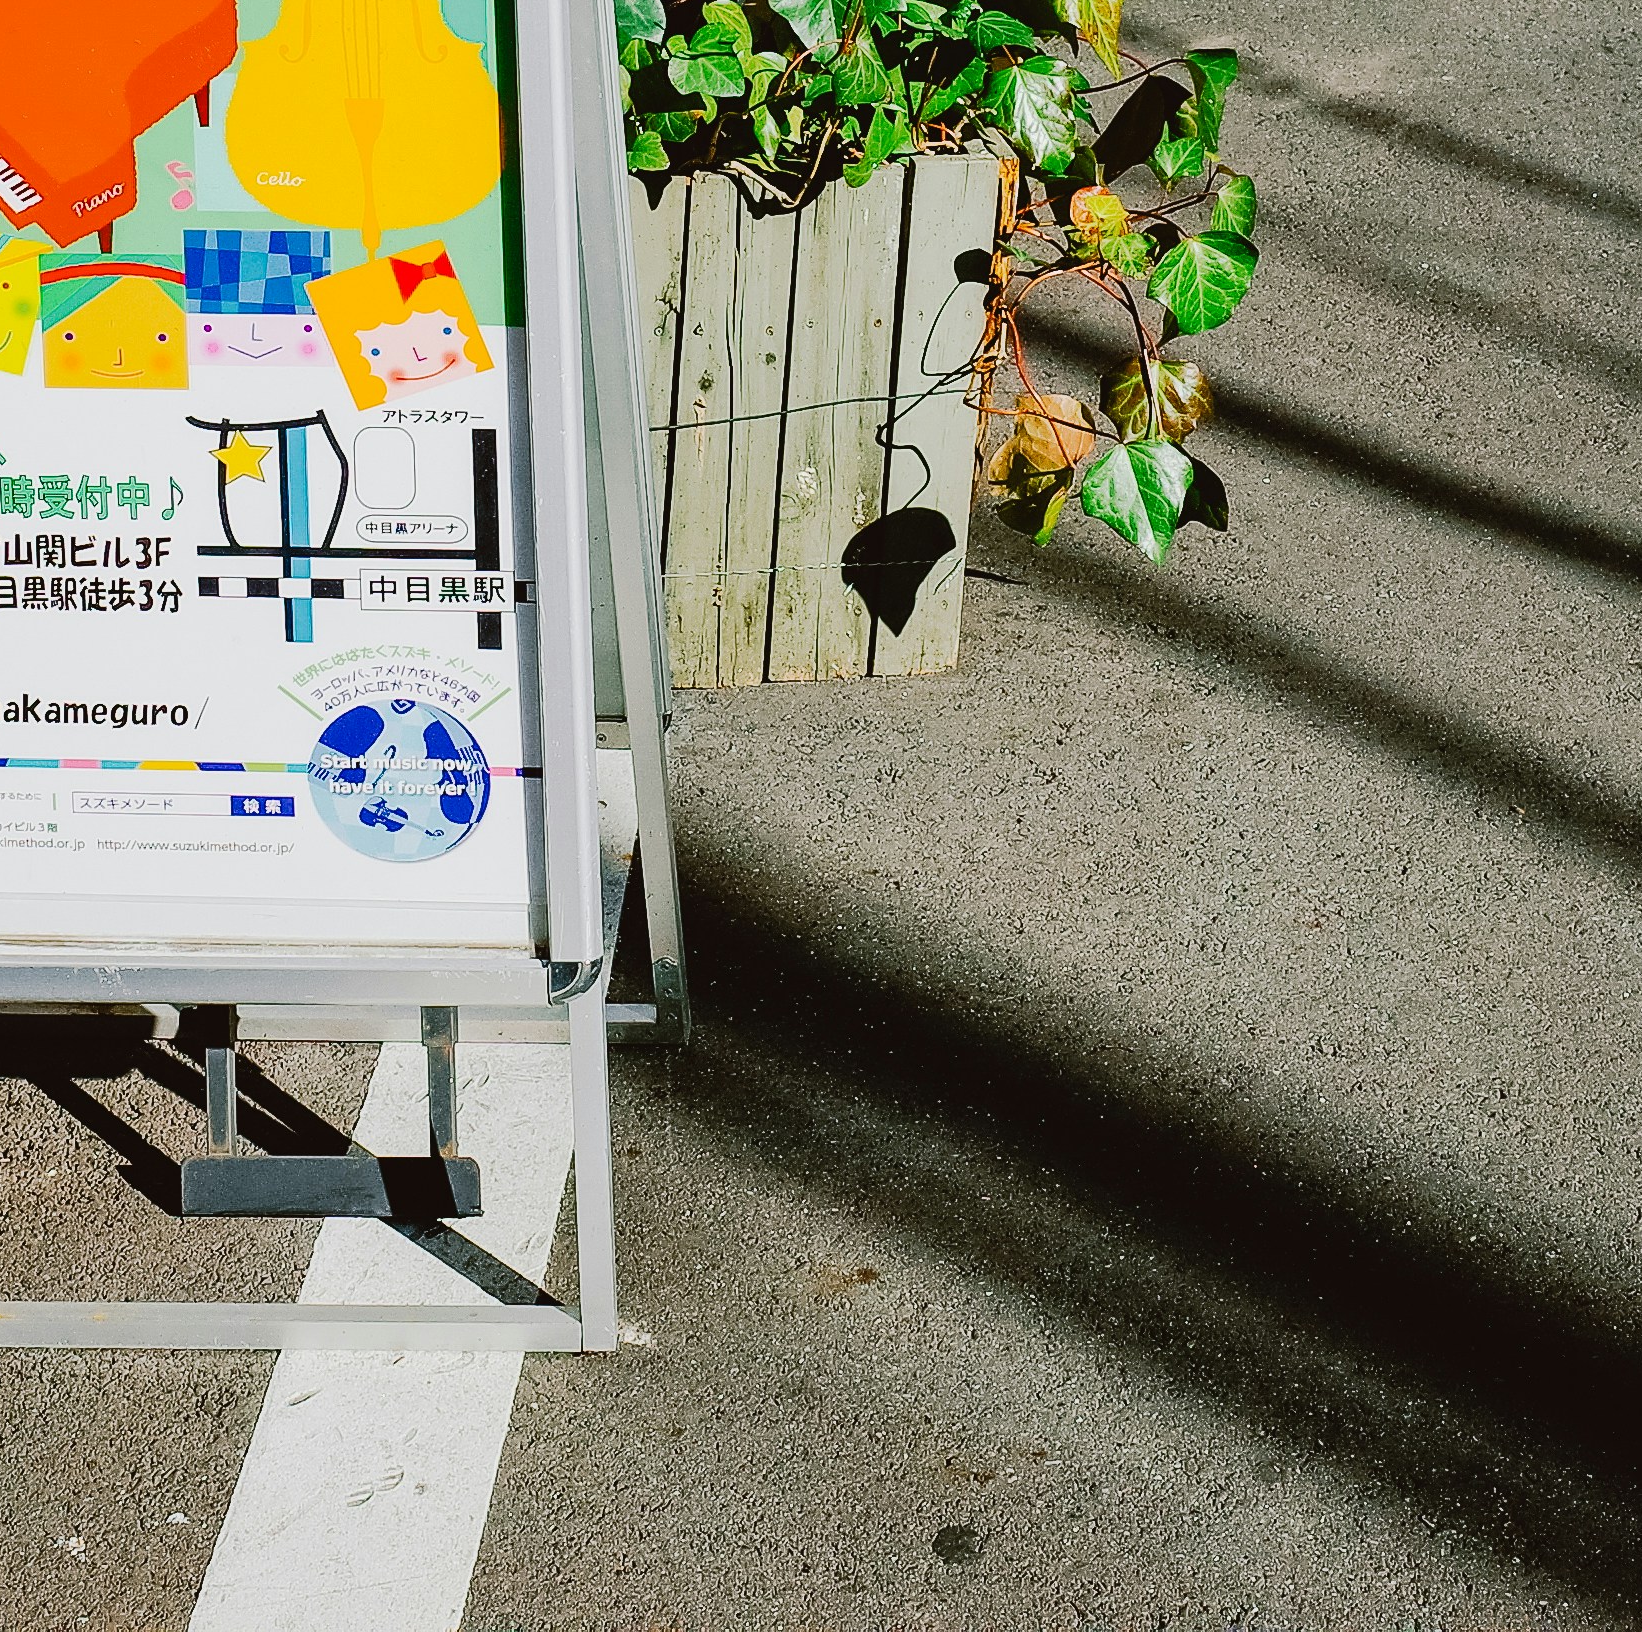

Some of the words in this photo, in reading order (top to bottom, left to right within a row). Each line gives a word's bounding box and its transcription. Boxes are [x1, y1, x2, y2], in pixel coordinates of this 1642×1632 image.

[256, 172, 306, 188] Cello
[72, 183, 124, 219] Piano
[383, 410, 484, 423] アトラスタワー
[365, 521, 459, 535] 中目黒アリーナ
[370, 575, 505, 603] 中目黒駅
[321, 754, 366, 770] Start
[373, 754, 428, 771] music
[330, 779, 373, 794] have
[379, 779, 393, 794] it
[398, 779, 465, 796] forever
[81, 798, 172, 810] スズキメソード
